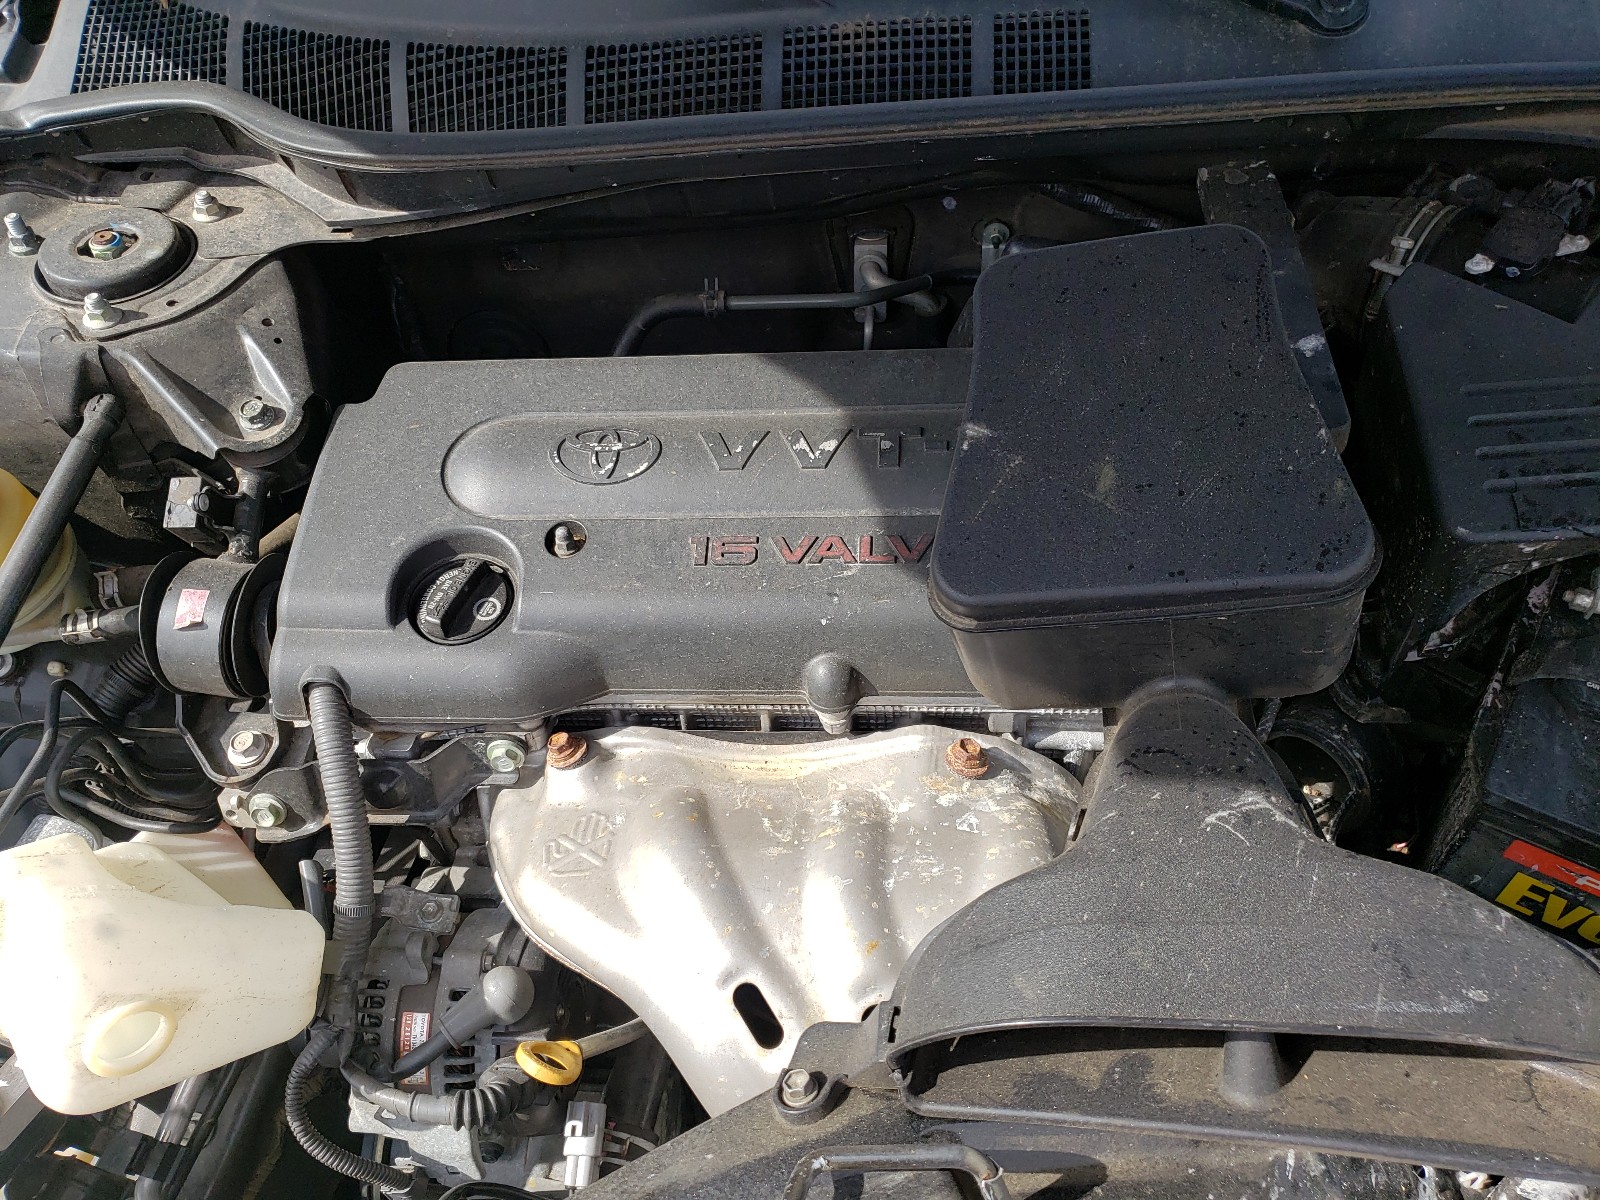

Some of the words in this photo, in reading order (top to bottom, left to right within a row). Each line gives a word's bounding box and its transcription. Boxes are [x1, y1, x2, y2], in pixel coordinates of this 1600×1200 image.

[698, 427, 950, 471] VVT-
[690, 534, 760, 566] 16
[770, 534, 936, 566] VALV
